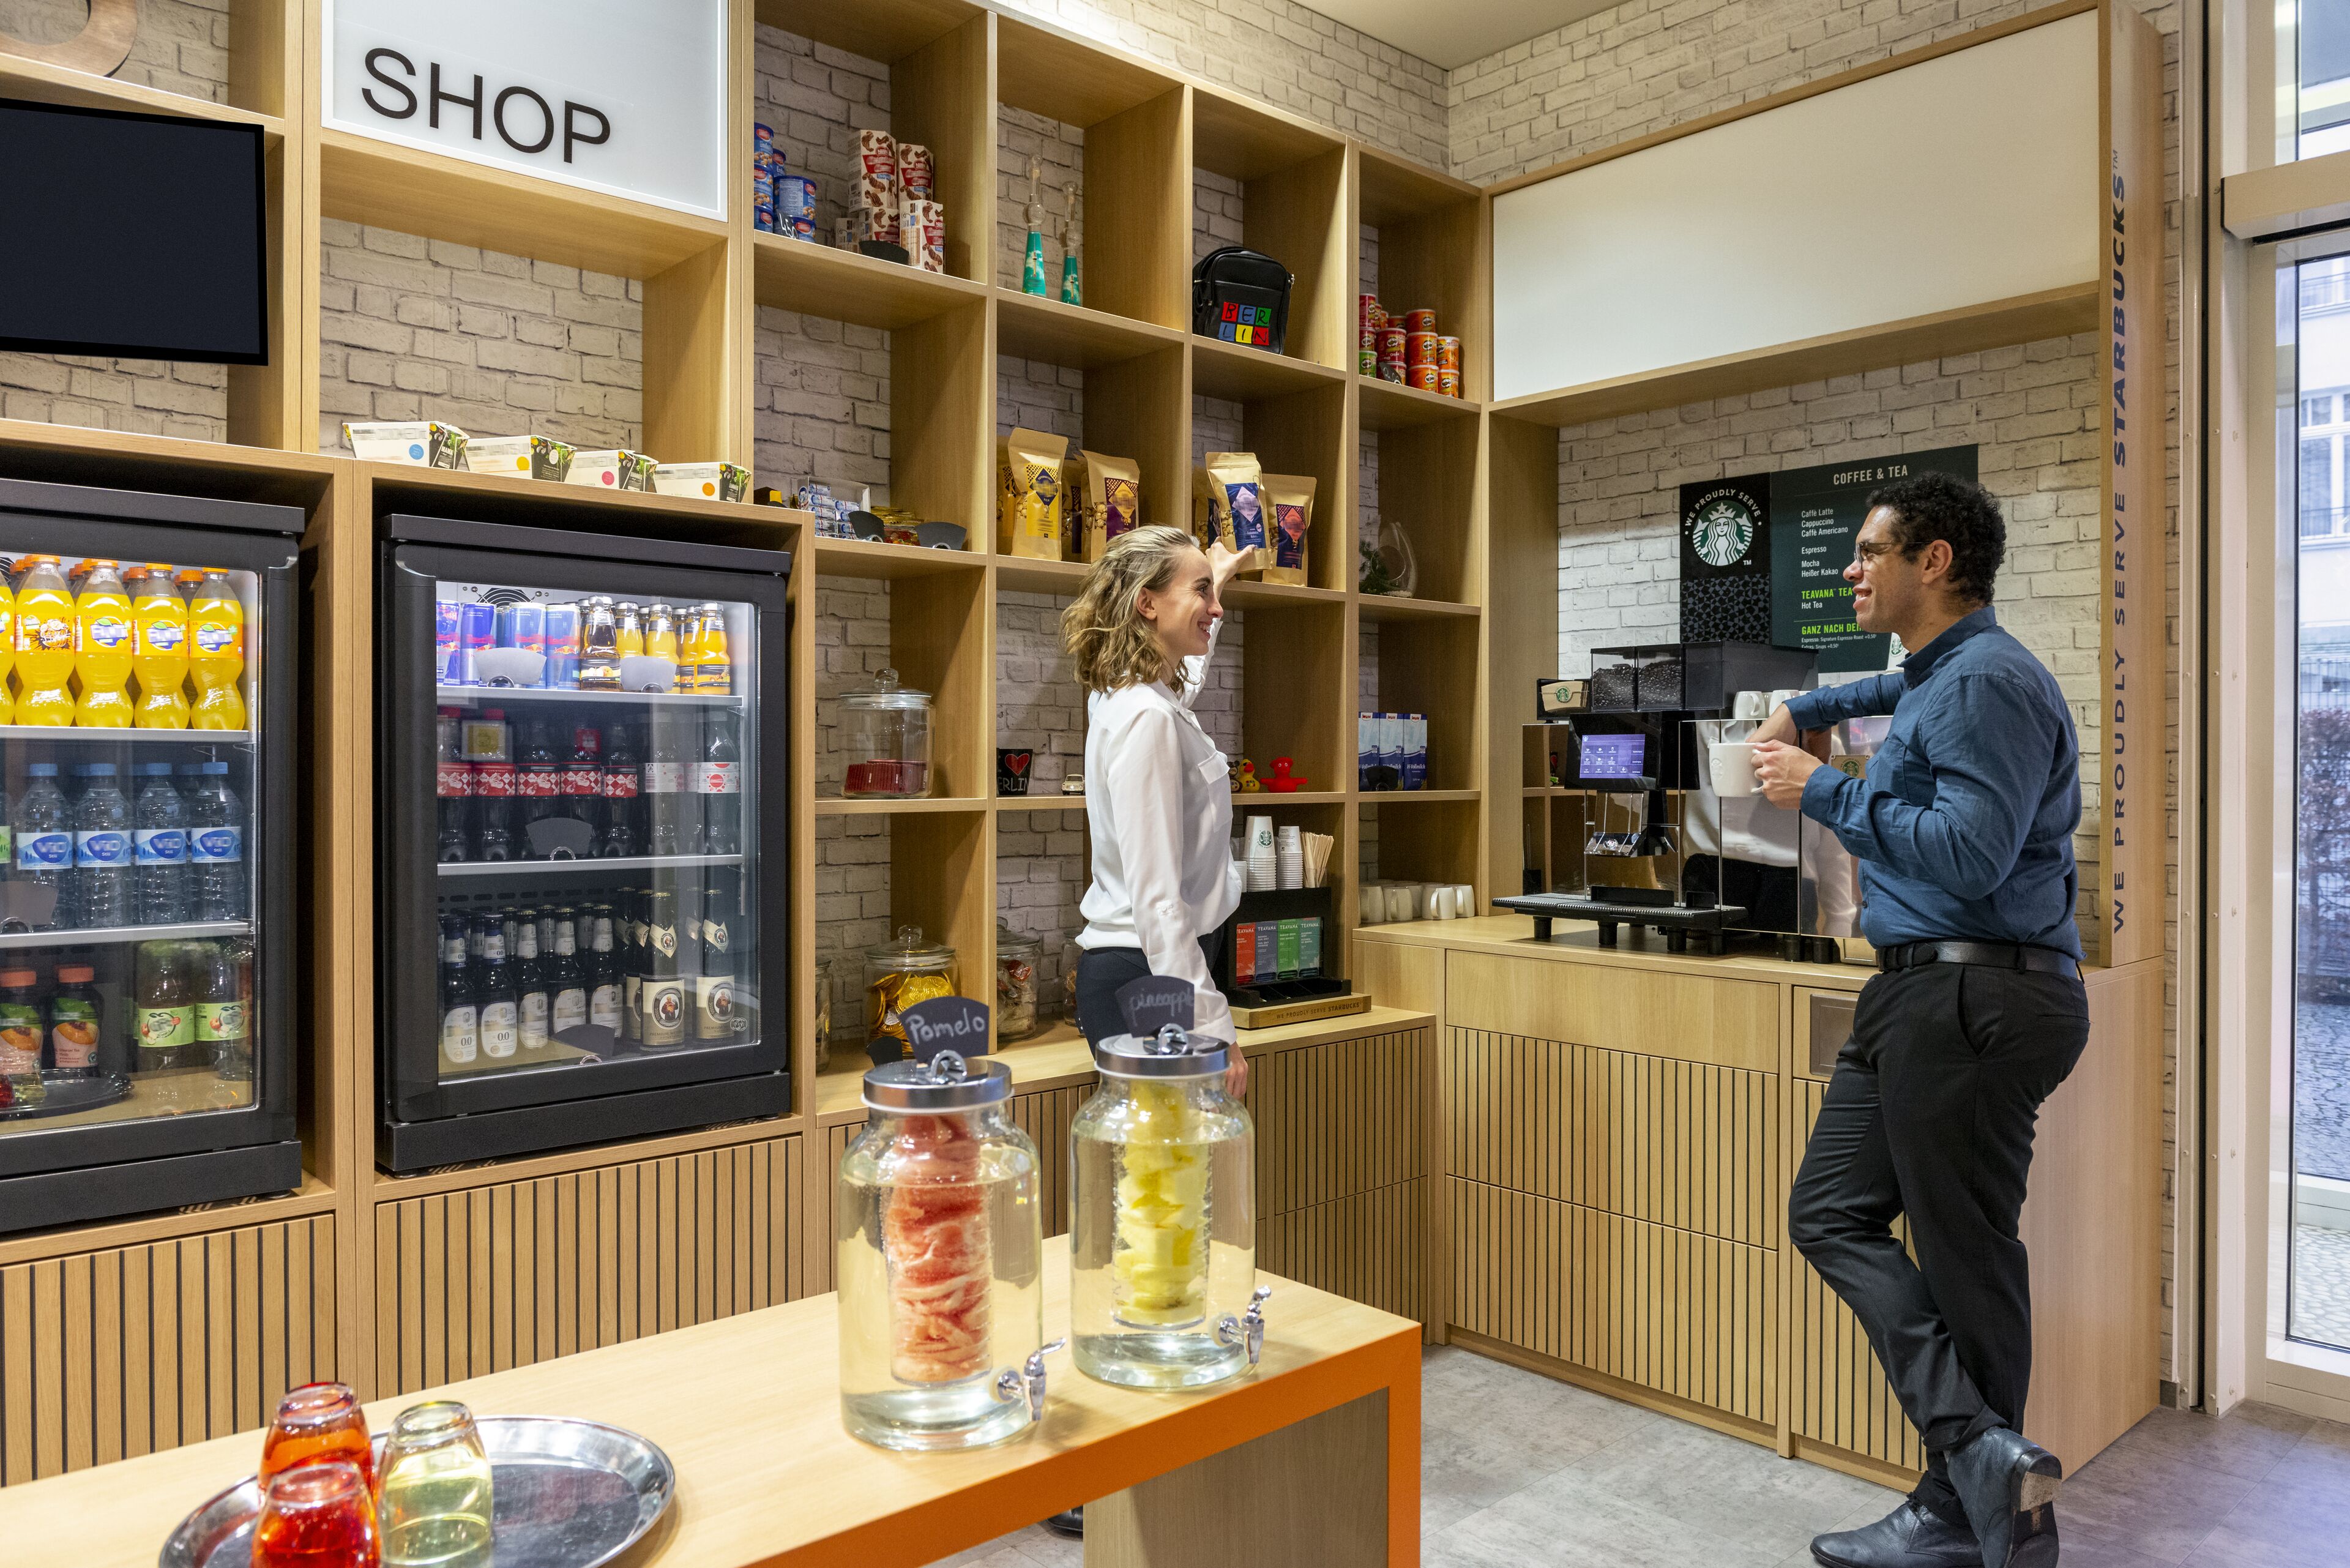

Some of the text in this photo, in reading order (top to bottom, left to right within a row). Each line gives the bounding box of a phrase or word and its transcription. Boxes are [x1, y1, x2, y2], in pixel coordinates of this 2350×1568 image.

[362, 47, 611, 164] SHOP
[1833, 465, 1908, 485] COFFEE & TEA
[1685, 489, 1761, 526] WE PROUDLY SERVE
[1802, 509, 1817, 518] Caffè
[1802, 518, 1834, 528] Cappuccino
[1802, 526, 1848, 537] Caffè Americano
[1802, 546, 1827, 554] Espresso
[2114, 492, 2125, 625] SERVE
[1802, 625, 1821, 635] GANZ
[1824, 624, 1843, 633] NACH
[2114, 648, 2125, 846] PROUDLY
[998, 777, 1029, 791] ERLIN
[2114, 870, 2125, 933] WE
[906, 1007, 985, 1044] Pomelo
[461, 1037, 472, 1047] 0.0
[498, 1032, 509, 1041] 0.0
